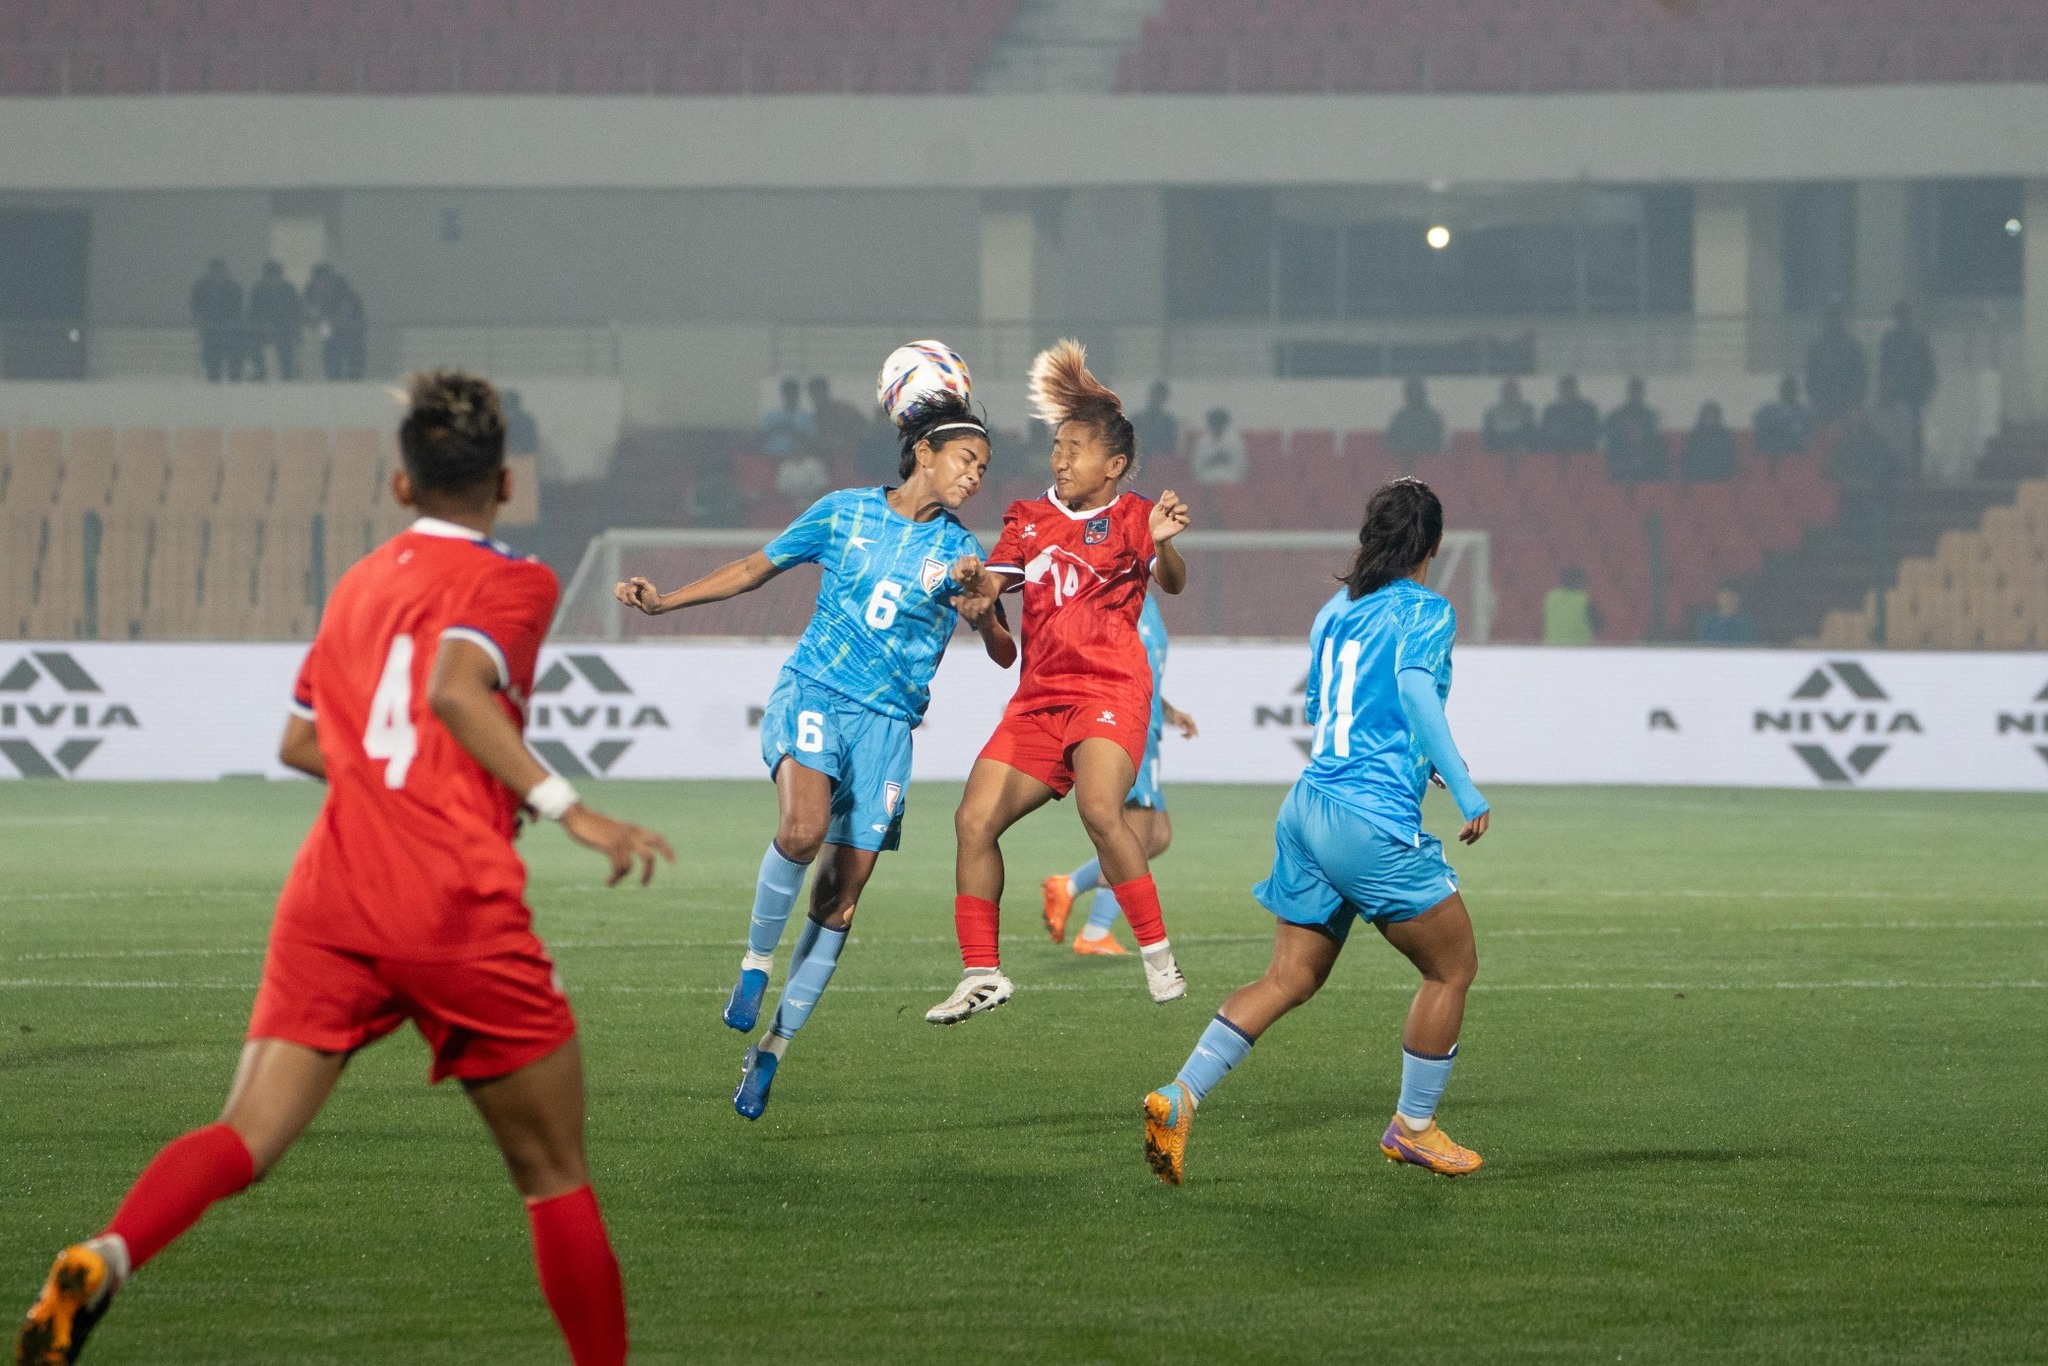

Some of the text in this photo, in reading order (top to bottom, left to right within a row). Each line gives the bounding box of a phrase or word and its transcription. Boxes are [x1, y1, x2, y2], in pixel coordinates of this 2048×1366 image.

[865, 580, 902, 630] 6
[0, 704, 140, 727] IVIA
[362, 634, 418, 789] 4
[537, 705, 669, 728] IVIA
[1313, 637, 1361, 758] 11
[796, 710, 824, 753] 6
[1754, 710, 1922, 733] NIVIA
